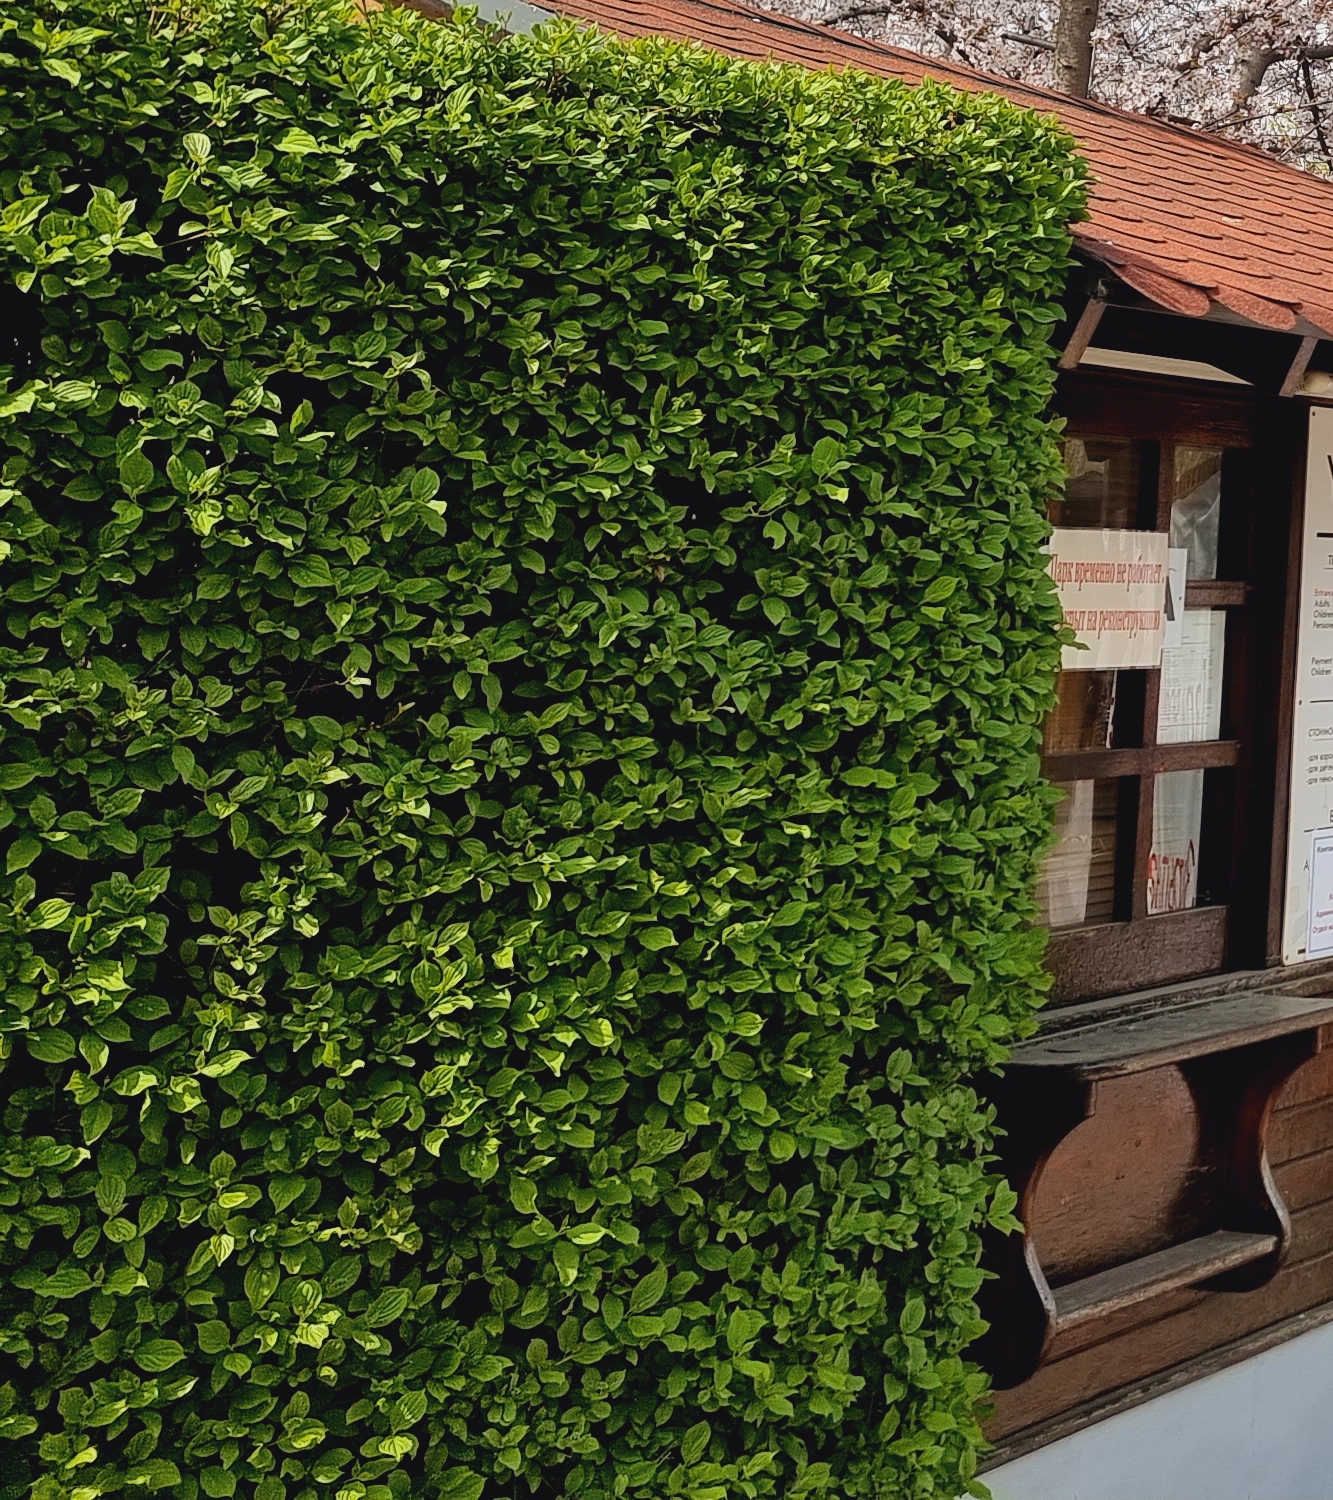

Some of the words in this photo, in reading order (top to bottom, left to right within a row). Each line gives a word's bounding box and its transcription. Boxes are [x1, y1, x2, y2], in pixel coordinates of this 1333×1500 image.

[1051, 553, 1074, 591] Парк
[1116, 563, 1126, 583] не
[1313, 610, 1333, 619] Children
[1087, 610, 1097, 631] на
[1311, 657, 1333, 666] Payment
[1311, 667, 1331, 676] Children
